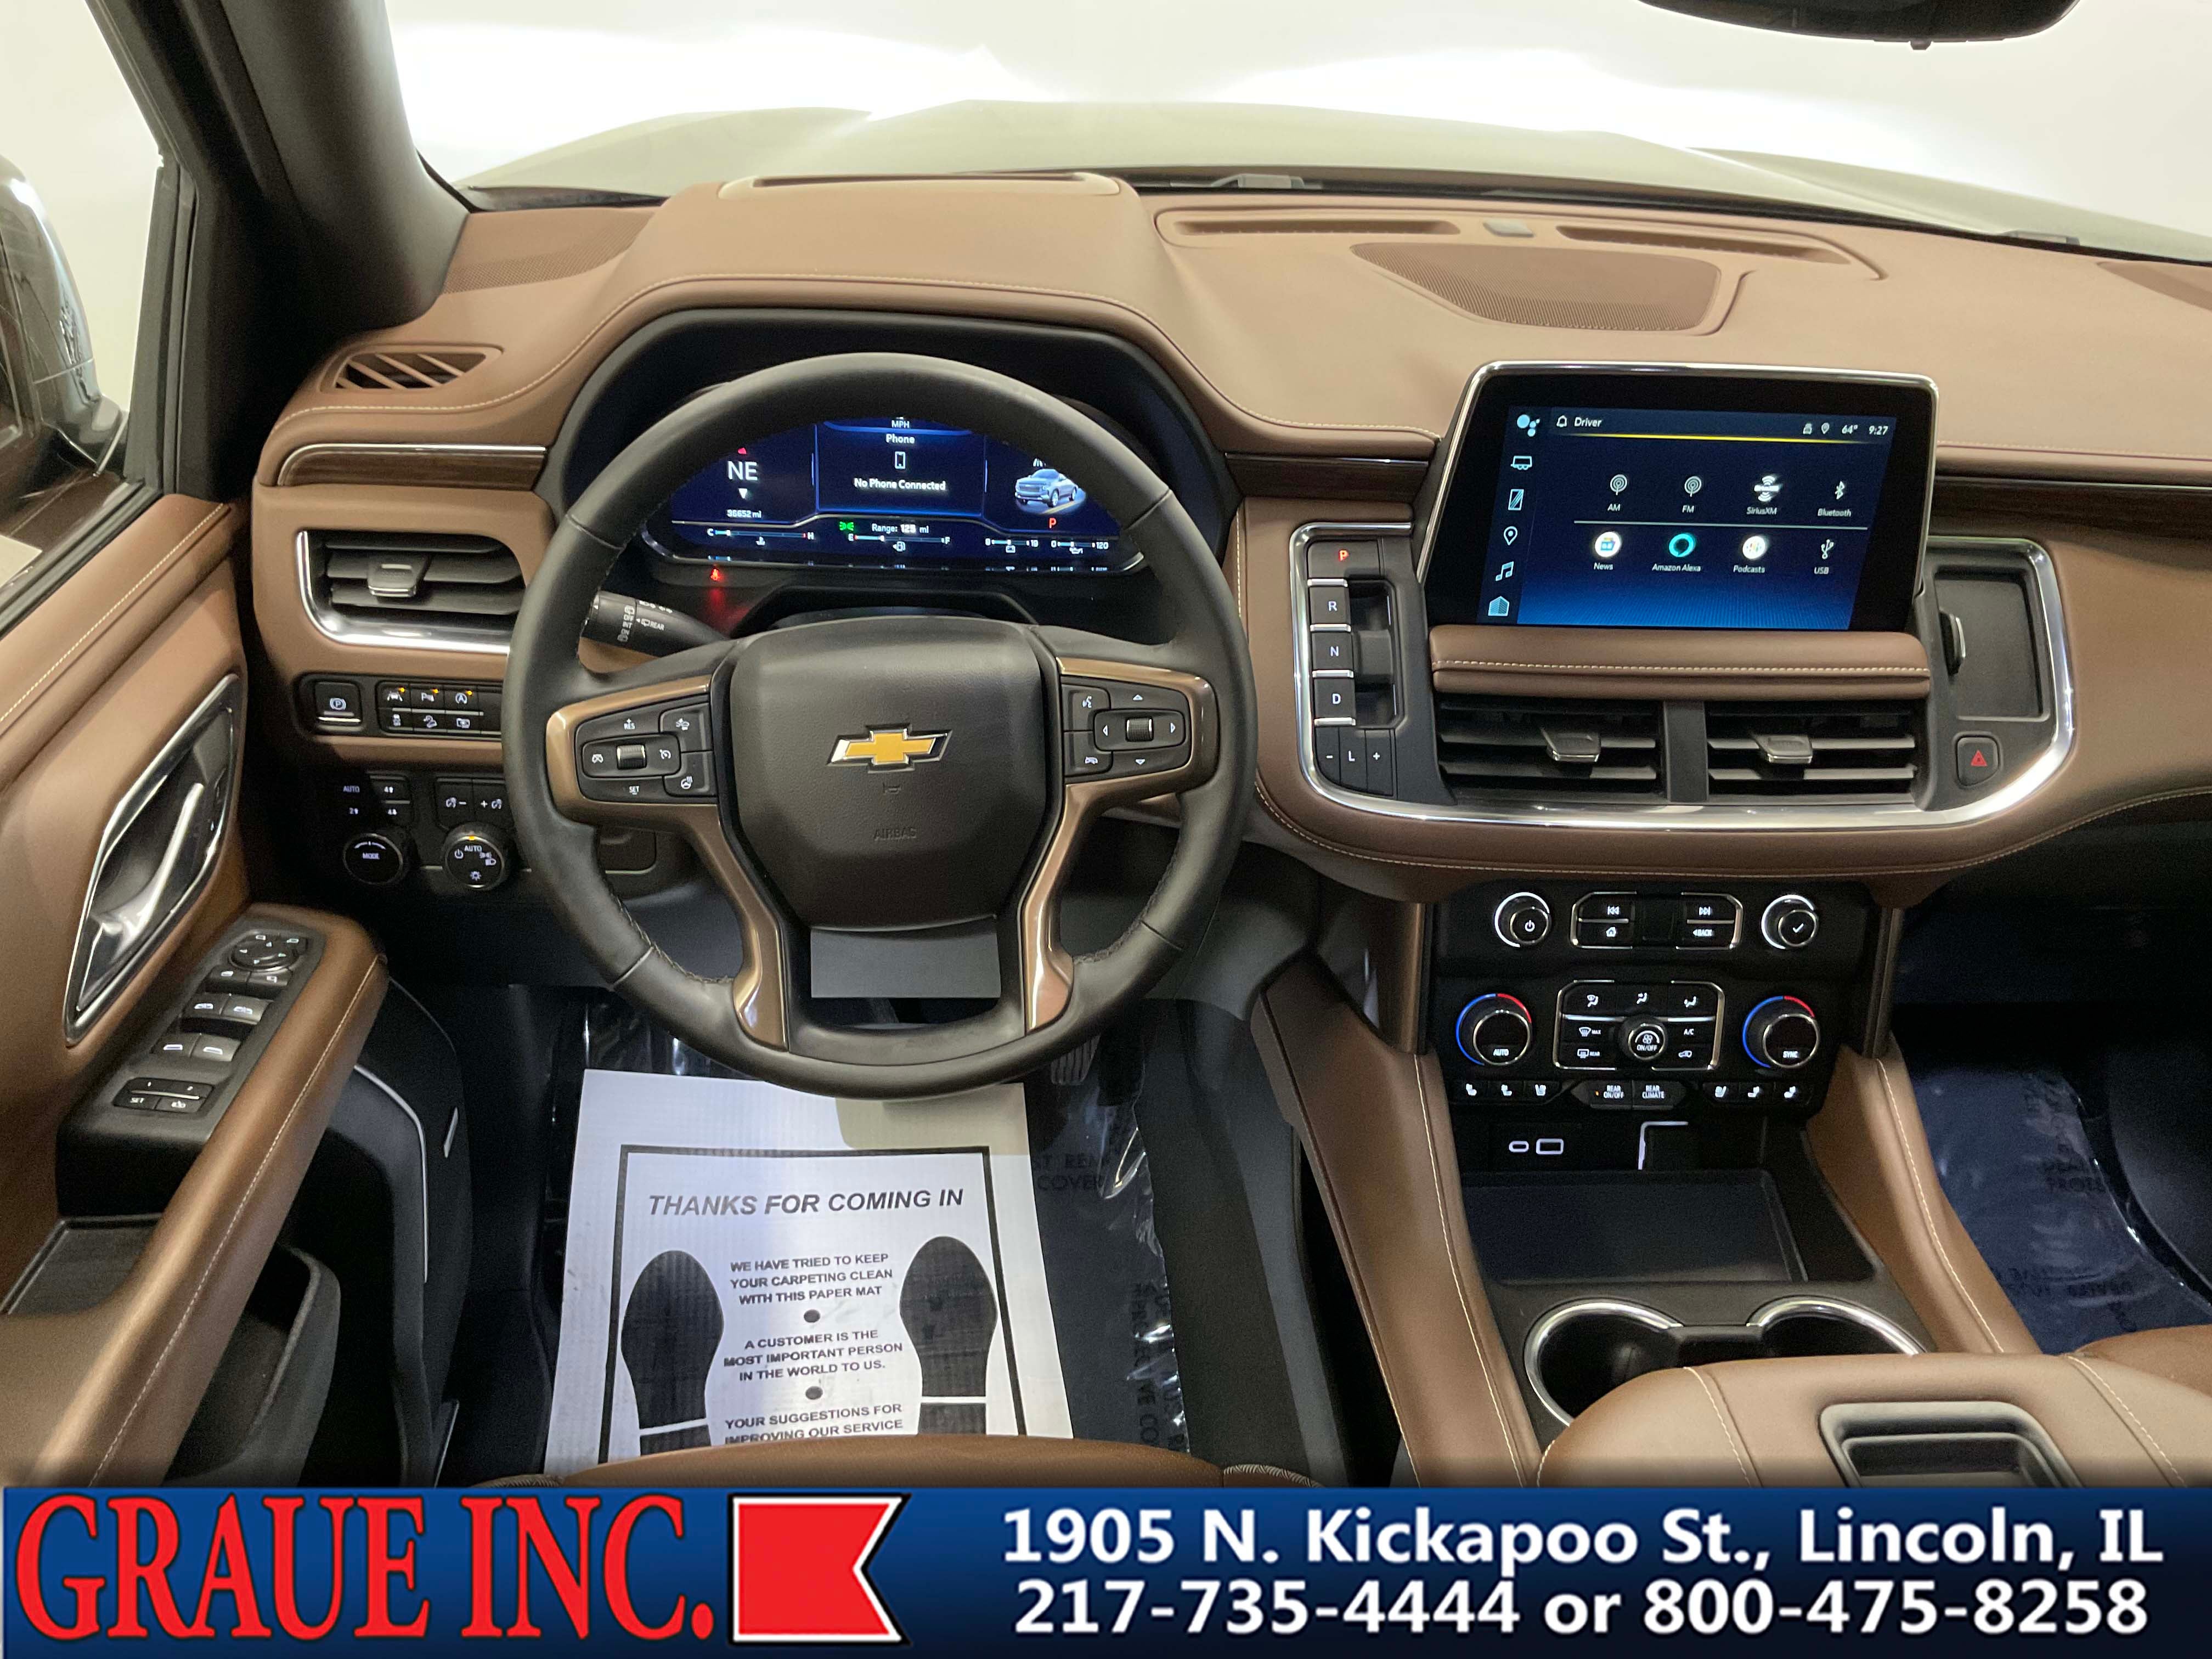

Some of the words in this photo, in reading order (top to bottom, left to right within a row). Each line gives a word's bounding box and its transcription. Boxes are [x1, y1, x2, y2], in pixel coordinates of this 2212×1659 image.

[891, 420, 910, 429] MPH
[1574, 416, 1602, 427] Driver
[1869, 425, 1888, 435] 9:27
[885, 433, 915, 444] Phone
[727, 460, 759, 481] NE
[854, 478, 868, 488] No
[869, 478, 897, 489] Phone
[898, 479, 946, 491] Connected
[1607, 504, 1621, 512] AM
[1681, 505, 1695, 514] FM
[1746, 506, 1778, 515] SiriusXM
[1817, 508, 1852, 517] Bluetooth
[752, 510, 762, 518] mi
[871, 523, 898, 534] Range:
[919, 525, 929, 533] mi
[1048, 517, 1057, 529] P
[707, 528, 714, 537] C
[807, 532, 815, 540] H
[848, 533, 855, 541] E
[945, 536, 951, 545] F
[1096, 541, 1109, 550] 120
[1339, 550, 1349, 561] P
[1593, 562, 1614, 571] News
[1651, 563, 1681, 572] Amazon
[1681, 564, 1702, 572] Alexa
[1733, 565, 1765, 574] Podcasts
[1813, 567, 1830, 575] USB
[1328, 601, 1338, 612] R
[622, 620, 633, 629] INT
[650, 620, 665, 631] REAR
[1329, 646, 1339, 657] N
[1332, 693, 1342, 705] D
[1347, 751, 1356, 762] L
[342, 785, 360, 793] AUTO
[629, 785, 640, 793] SET
[873, 826, 918, 841] AIRBAG
[1493, 1048, 1509, 1057] AUTO
[649, 1195, 757, 1216] THANKS
[764, 1193, 820, 1215] FOR
[828, 1190, 931, 1212] COMING
[939, 1188, 964, 1206] IN
[730, 1261, 751, 1272] WE
[755, 1259, 790, 1271] HAVE
[792, 1257, 831, 1268] TRIED
[833, 1256, 851, 1266] TO
[855, 1253, 889, 1264] KEEP
[730, 1277, 768, 1289] YOUR
[771, 1272, 847, 1286] CARPETING
[850, 1269, 893, 1280] CLEAN
[738, 1293, 772, 1305] WITH
[775, 1291, 805, 1302] THIS
[809, 1288, 851, 1300] PAPER
[855, 1286, 882, 1296] MAT
[744, 1340, 755, 1350] A
[758, 1333, 833, 1348] CUSTOMER
[837, 1331, 849, 1341] IS
[852, 1330, 878, 1339] THE
[723, 1354, 763, 1367] MOST
[766, 1347, 845, 1364] IMPORTANT
[848, 1342, 904, 1356] PERSON
[740, 1372, 753, 1381] IN
[757, 1369, 785, 1380] THE
[787, 1363, 838, 1376] WORLD
[842, 1362, 860, 1372] TO
[864, 1360, 885, 1370] US.
[725, 1417, 766, 1430] YOUR
[769, 1406, 870, 1425] SUGGESTIONS
[873, 1403, 903, 1415] FOR
[725, 1429, 805, 1445] IMPROVING
[808, 1426, 840, 1438] OUR
[844, 1419, 904, 1434] SERVICE
